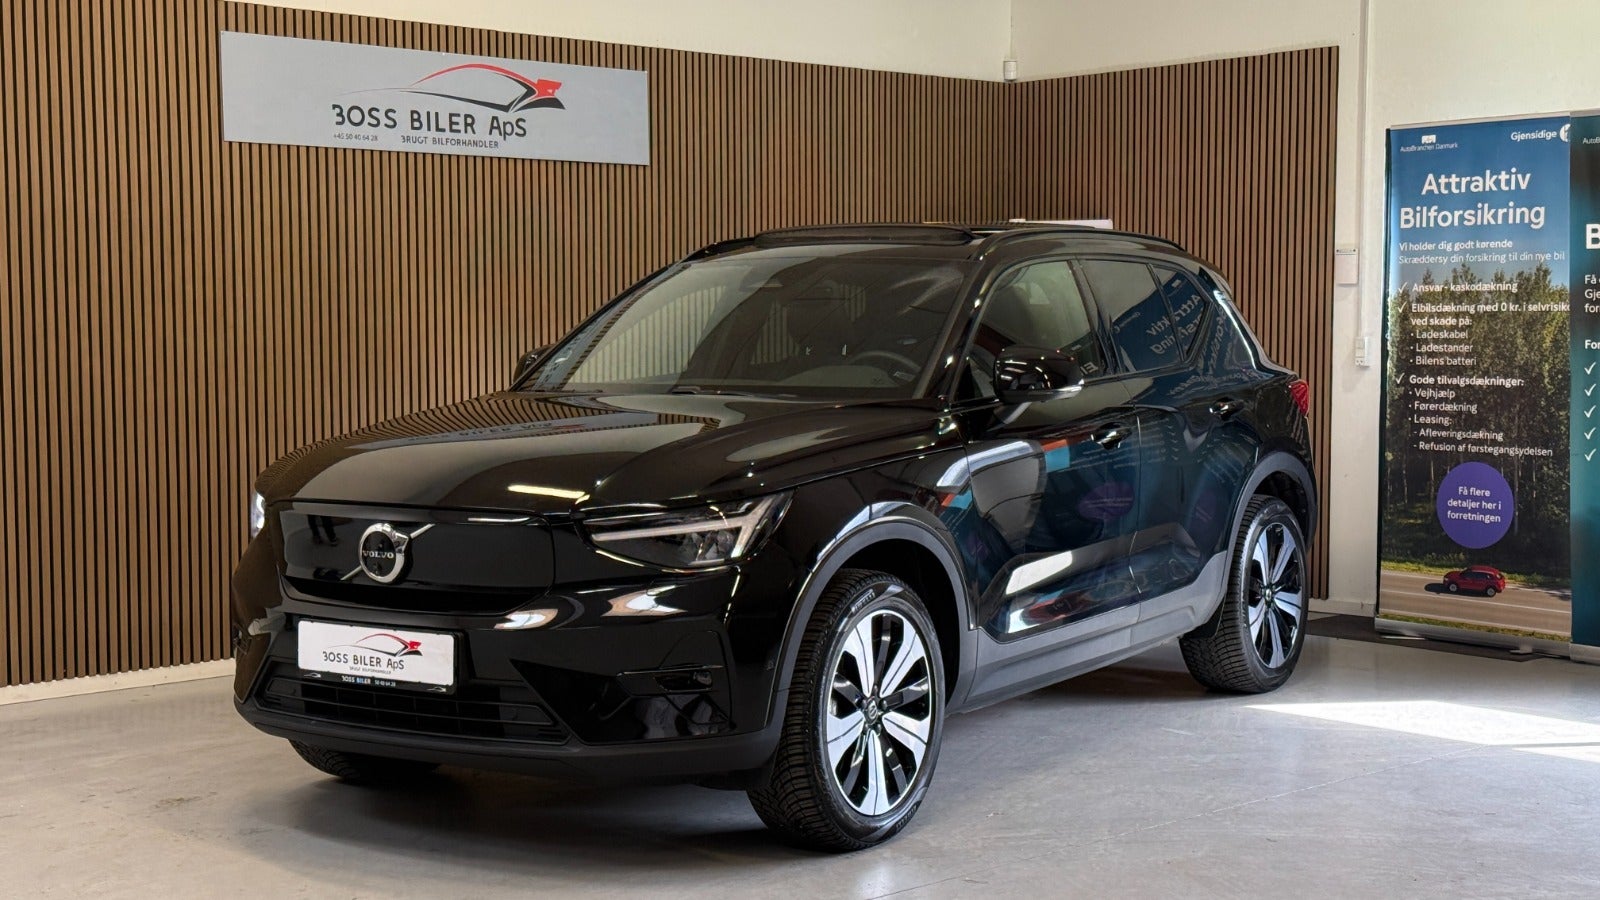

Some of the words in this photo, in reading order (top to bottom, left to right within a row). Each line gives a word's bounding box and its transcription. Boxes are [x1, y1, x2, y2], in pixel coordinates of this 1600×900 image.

[410, 110, 476, 134] BILER
[488, 116, 526, 140] ApS
[1510, 129, 1557, 142] Gjensidige
[432, 136, 498, 149] BILFORHANDLER
[1421, 167, 1531, 196] Attraktiv
[1400, 201, 1546, 230] Bilforsikring
[1399, 242, 1408, 252] Vi
[1409, 242, 1436, 251] holder
[1438, 240, 1452, 252] dig
[1454, 240, 1475, 252] godt
[1476, 238, 1513, 250] kørende
[1399, 254, 1448, 266] Skræddersy
[1450, 253, 1464, 263] din
[1466, 252, 1506, 264] forsikring
[1508, 252, 1518, 261] til
[1520, 251, 1534, 261] din
[1536, 252, 1552, 262] nye
[1554, 250, 1565, 260] bil
[1584, 274, 1597, 284] Få
[1450, 282, 1518, 294] kaskodækning
[1412, 302, 1476, 314] Elbilsdækning
[1477, 302, 1499, 312] med
[1501, 302, 1507, 312] 0
[1509, 302, 1521, 312] kr.
[1523, 302, 1526, 312] i
[1411, 316, 1428, 326] ved
[1430, 316, 1457, 326] skade
[1458, 316, 1472, 328] på:
[1416, 330, 1469, 339] Ladeskabel
[1416, 342, 1474, 352] Ladestander
[1415, 355, 1445, 366] Bilens
[1446, 356, 1477, 366] batteri
[1409, 374, 1435, 384] Gode
[1437, 375, 1524, 388] tilvalgsdækninger:
[1414, 388, 1456, 400] Vejhjælp
[1414, 400, 1478, 414] Førerdækning
[1419, 428, 1504, 442] Afleveringsdækning
[1419, 441, 1456, 451] Refusion
[1457, 444, 1466, 452] af
[1468, 444, 1553, 458] førstegangsydelsen
[1458, 486, 1468, 496] Få
[1470, 487, 1490, 497] flere
[1447, 498, 1480, 510] detaljer
[1482, 500, 1497, 510] her
[1498, 500, 1502, 510] i
[1447, 510, 1502, 524] forretningen
[362, 550, 394, 559] VOLVO
[352, 654, 382, 668] BILER
[386, 658, 404, 671] ApS
